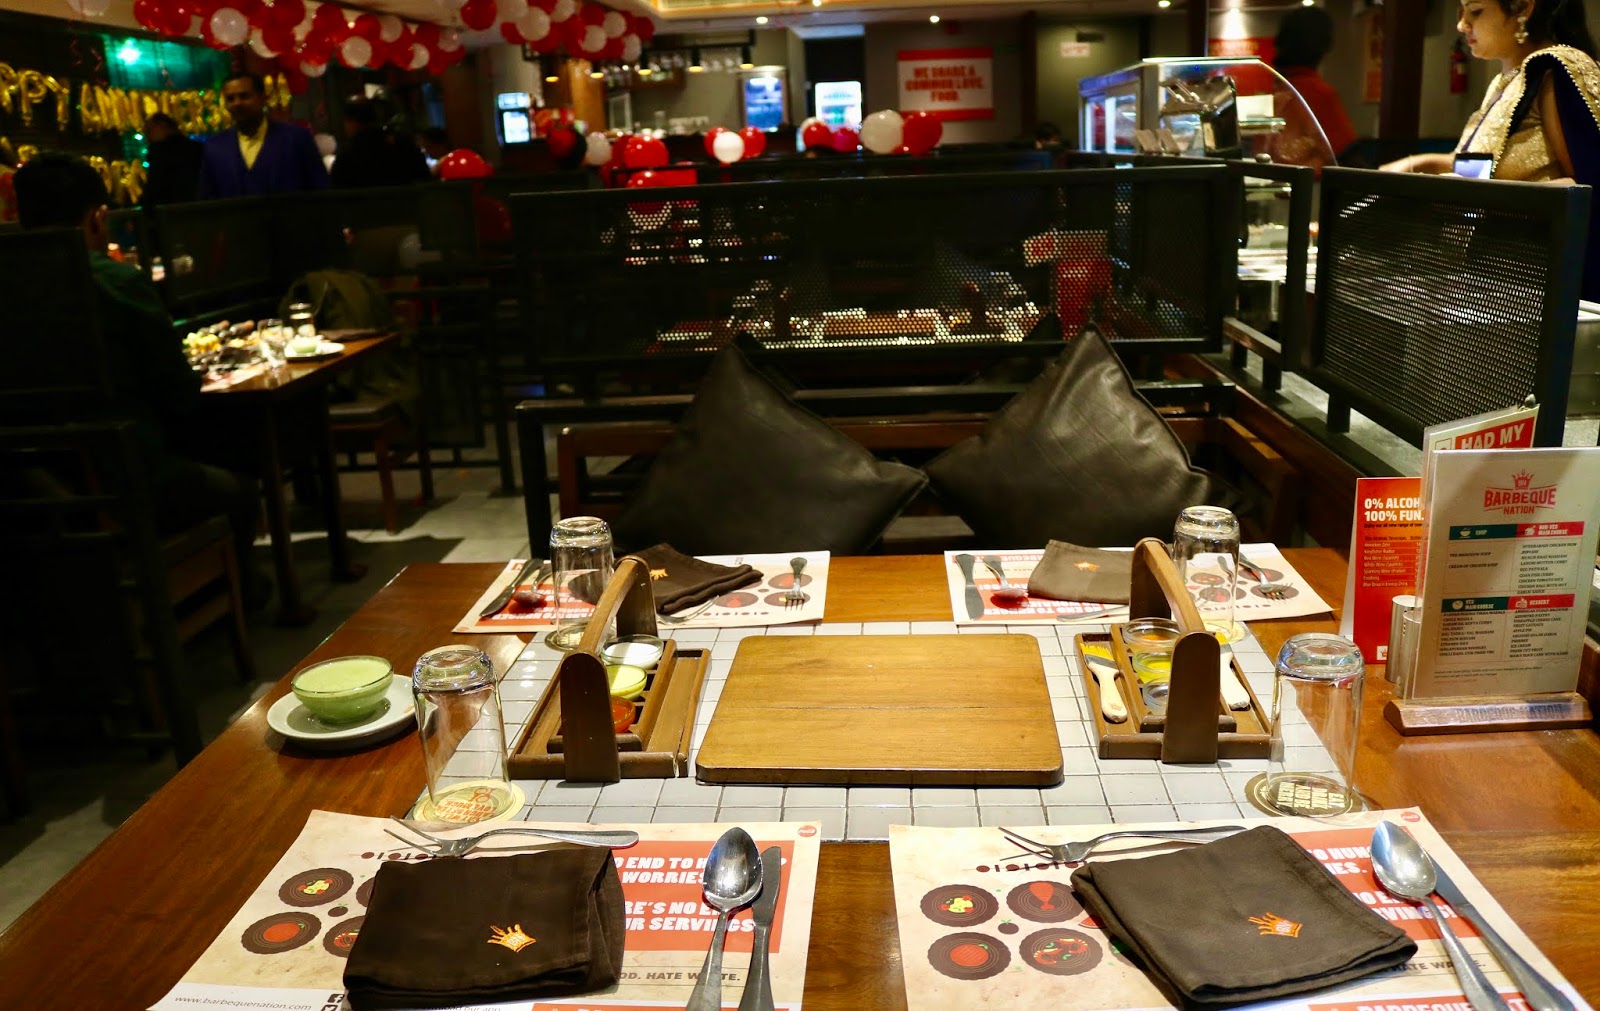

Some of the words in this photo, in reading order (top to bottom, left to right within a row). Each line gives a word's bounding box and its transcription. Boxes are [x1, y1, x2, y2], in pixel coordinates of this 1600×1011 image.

[1461, 432, 1495, 450] HAD
[1500, 423, 1525, 445] MY
[1364, 498, 1384, 509] 0%
[1484, 488, 1557, 508] BARBEQUE
[1364, 510, 1398, 522] 100%
[1399, 510, 1425, 521] FUN.
[1503, 506, 1535, 515] NATION
[625, 857, 665, 869] END
[668, 857, 694, 869] TO
[669, 902, 697, 915] NO
[646, 971, 683, 981] HATE
[687, 971, 741, 982] WTE.
[174, 996, 313, 1011] www.barbequenation.com
